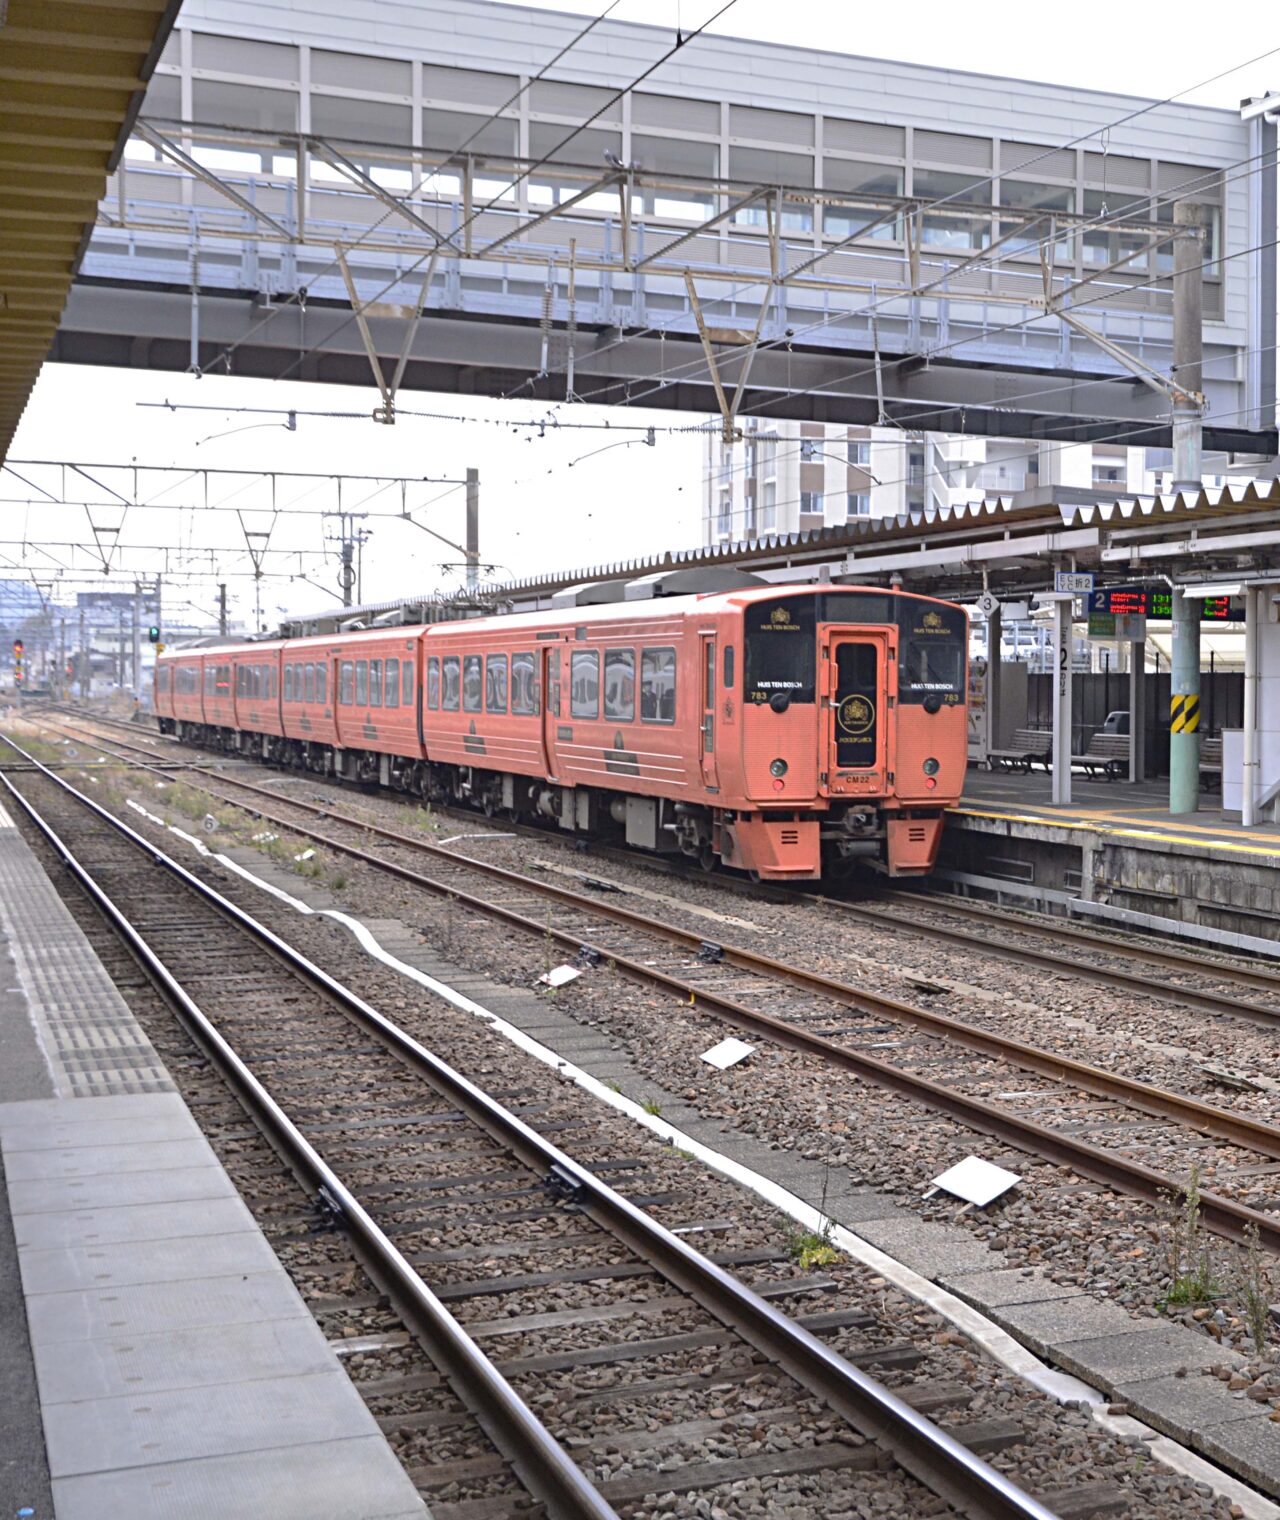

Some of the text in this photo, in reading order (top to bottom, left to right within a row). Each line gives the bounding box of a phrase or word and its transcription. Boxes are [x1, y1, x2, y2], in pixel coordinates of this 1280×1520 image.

[983, 597, 992, 611] 3
[1095, 592, 1106, 608] 2
[1152, 594, 1173, 603] 13:1
[1060, 647, 1068, 671] 2
[771, 681, 783, 689] TEN
[751, 692, 767, 700] 783
[205, 817, 214, 830] 6
